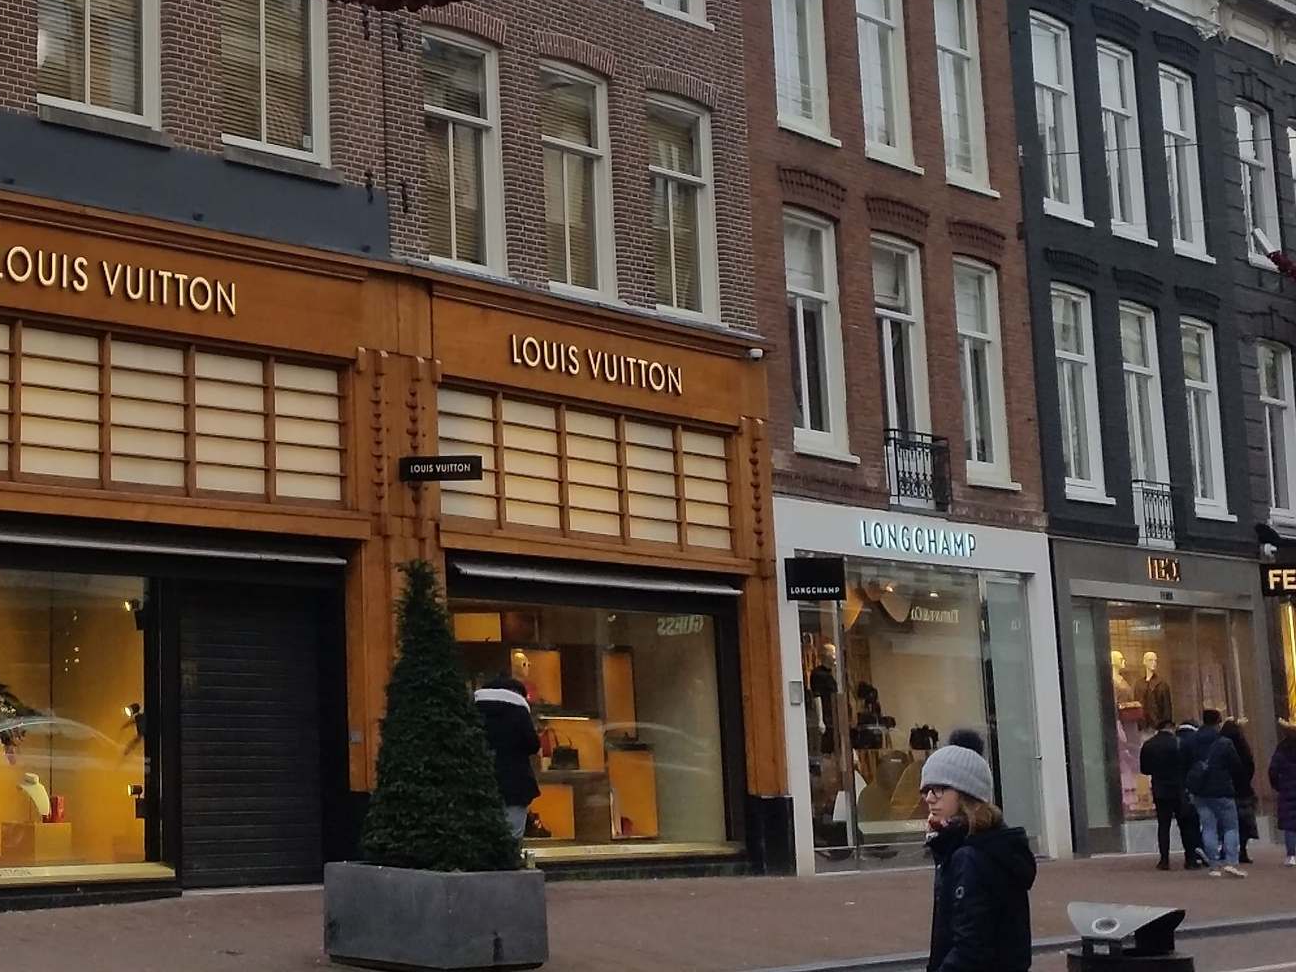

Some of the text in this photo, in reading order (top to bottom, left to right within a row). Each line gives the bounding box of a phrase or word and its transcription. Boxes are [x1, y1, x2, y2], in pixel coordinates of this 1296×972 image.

[101, 260, 237, 317] VUITTON
[511, 333, 683, 396] LOUIS VUITTON
[410, 462, 471, 474] LOUIS VUITTON
[860, 519, 978, 558] LONGCHAMP
[790, 586, 840, 595] LONGCHAMP
